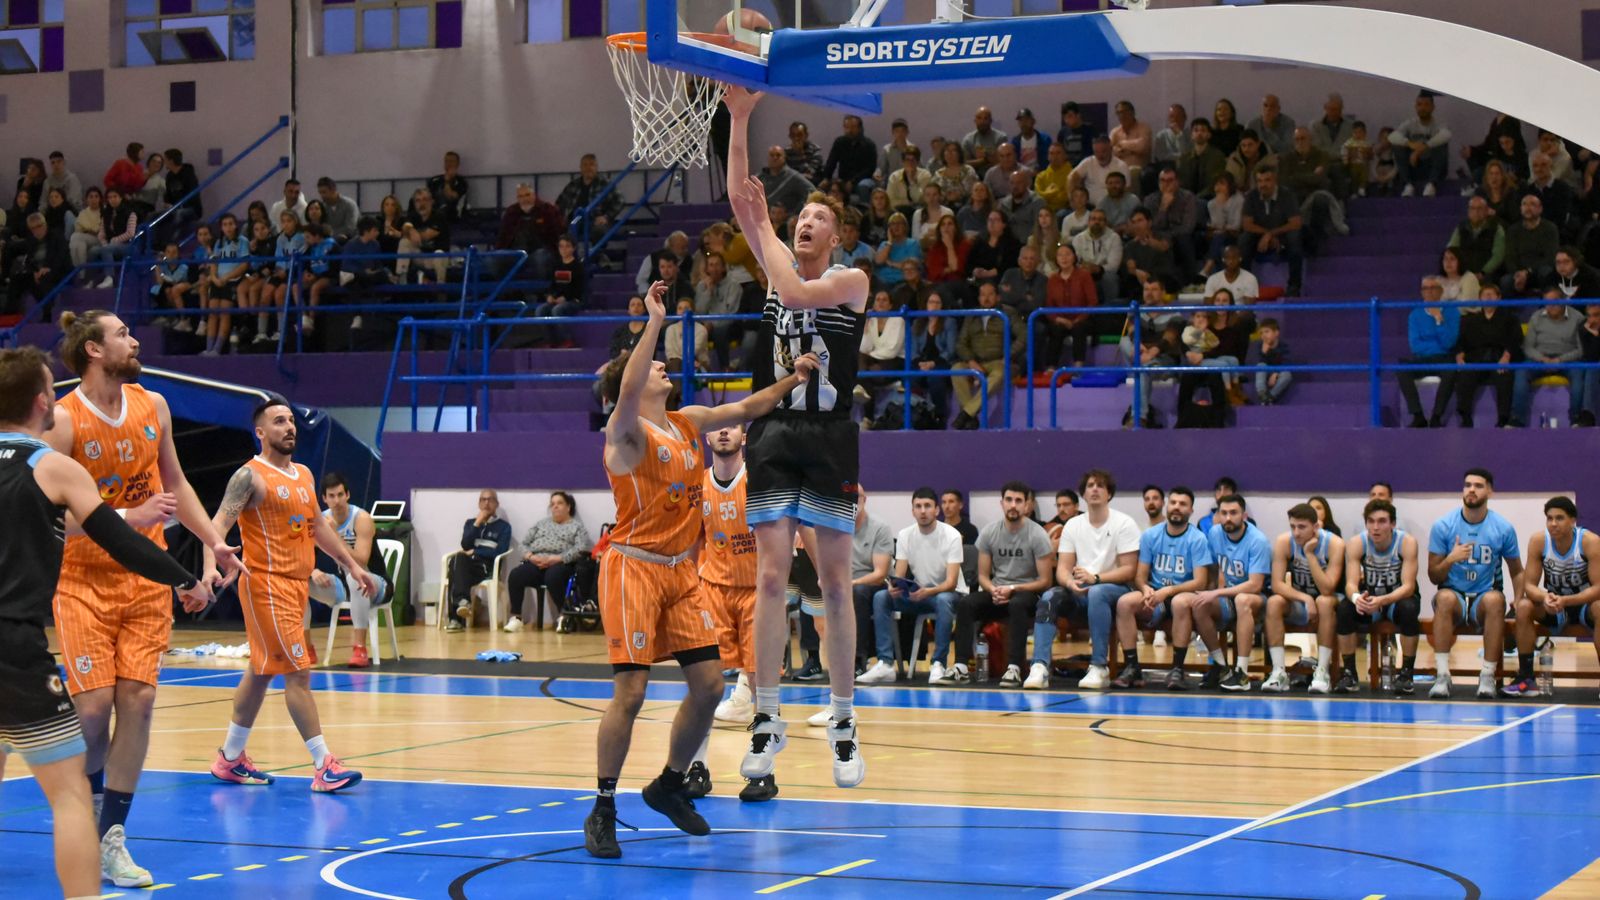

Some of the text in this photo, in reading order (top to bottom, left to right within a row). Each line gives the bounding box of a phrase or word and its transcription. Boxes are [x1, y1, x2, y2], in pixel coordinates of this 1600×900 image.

[116, 439, 136, 464] 12
[296, 486, 311, 504] 13
[719, 500, 737, 521] 55
[731, 532, 756, 541] MELILL
[998, 548, 1024, 557] ULB
[1467, 543, 1493, 565] LB
[1154, 553, 1185, 574] ULB
[1217, 553, 1245, 578] ULB
[1466, 571, 1478, 581] 10
